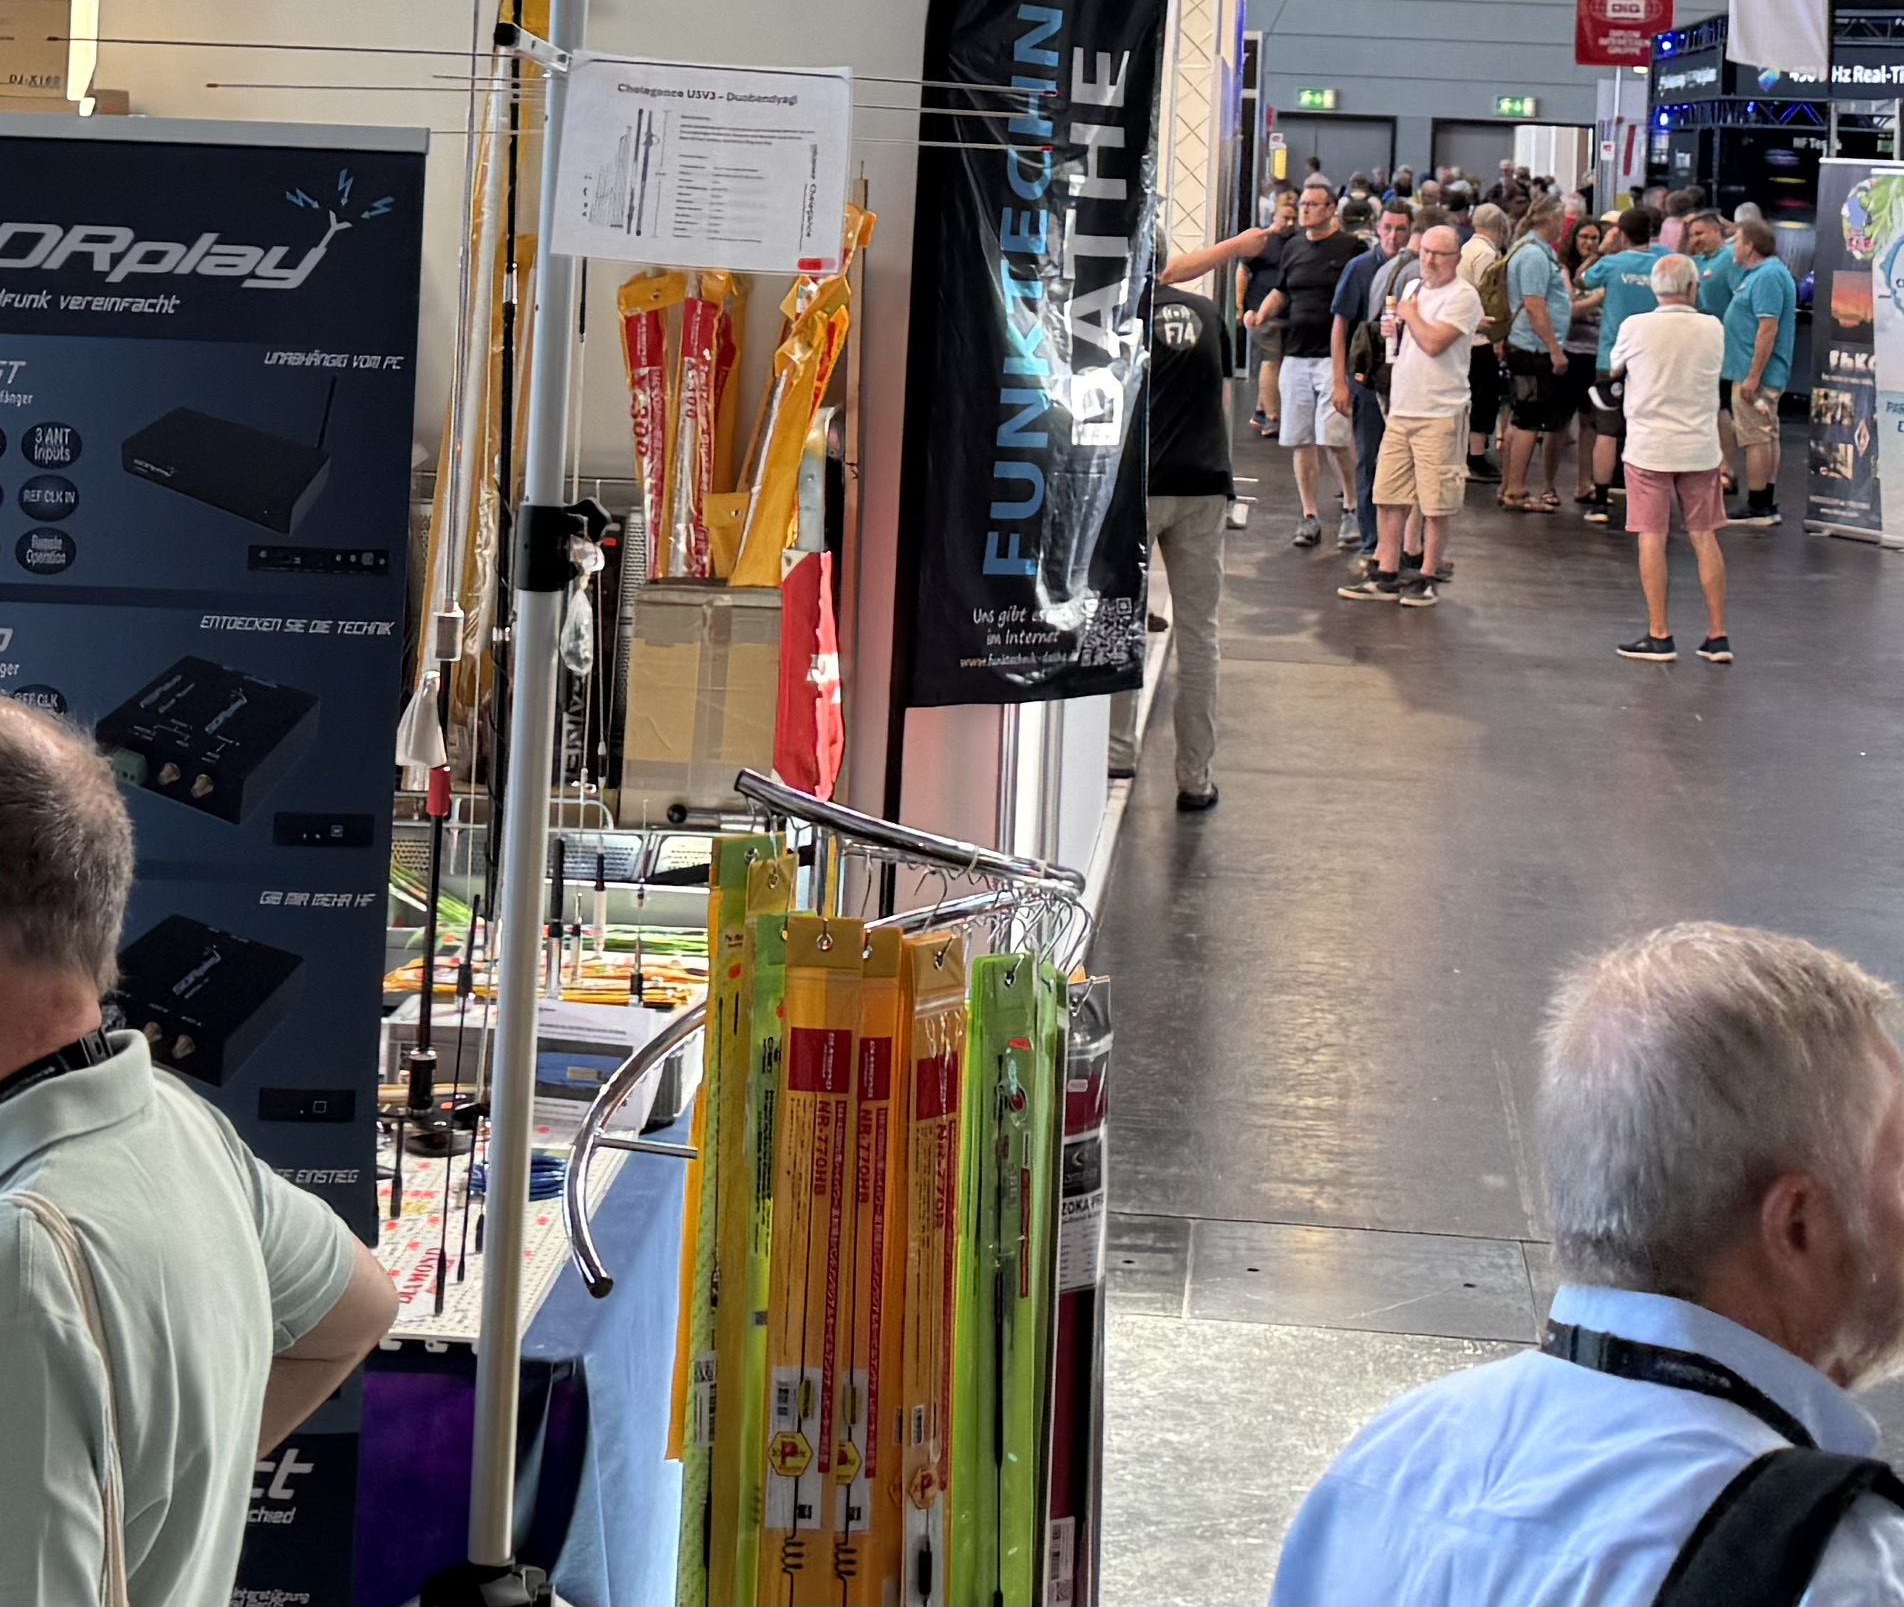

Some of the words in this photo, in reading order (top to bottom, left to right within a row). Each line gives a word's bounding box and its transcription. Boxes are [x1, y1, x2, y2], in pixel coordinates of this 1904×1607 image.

[1063, 47, 1129, 448] DATHE
[383, 355, 404, 370] PC
[35, 428, 43, 442] 3
[47, 428, 70, 445] ANT
[34, 446, 71, 462] Inputs
[200, 615, 281, 633] ENTDECKEN
[337, 620, 395, 636] TECHNIK
[1005, 630, 1059, 645] Internet
[296, 1170, 359, 1183] EINSTIEG
